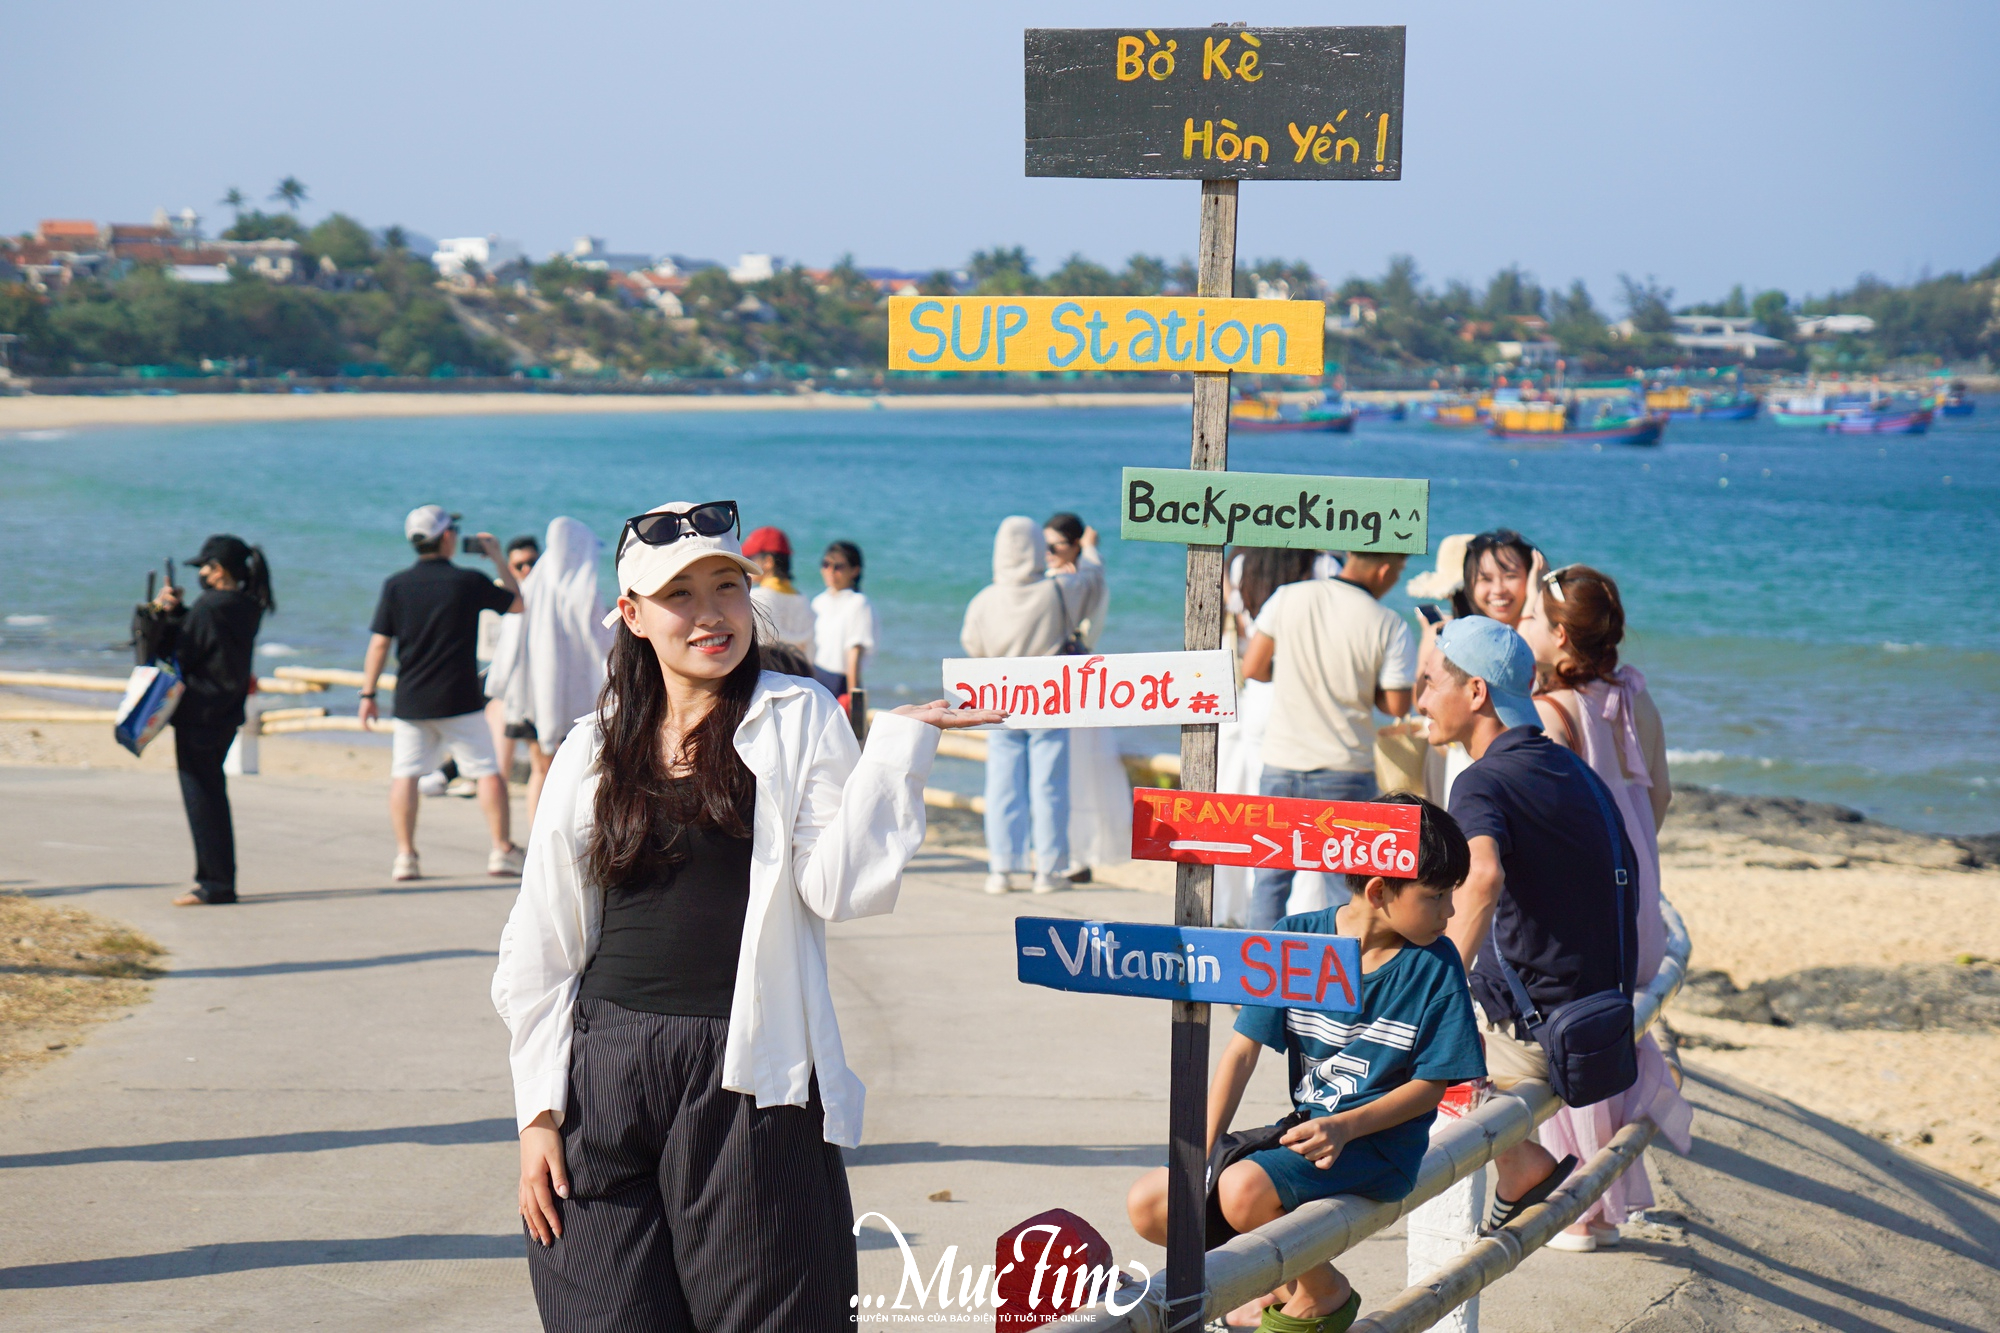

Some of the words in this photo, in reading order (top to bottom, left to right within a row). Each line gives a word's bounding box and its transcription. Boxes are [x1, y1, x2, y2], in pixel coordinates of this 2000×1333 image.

[1116, 29, 1178, 82] Bờ
[1202, 31, 1263, 82] Kè
[1183, 117, 1270, 163] Hòn
[907, 301, 1029, 365] SUP
[1047, 301, 1288, 368] Station
[1142, 794, 1289, 830] TRAVEL
[1239, 935, 1356, 1006] SEA
